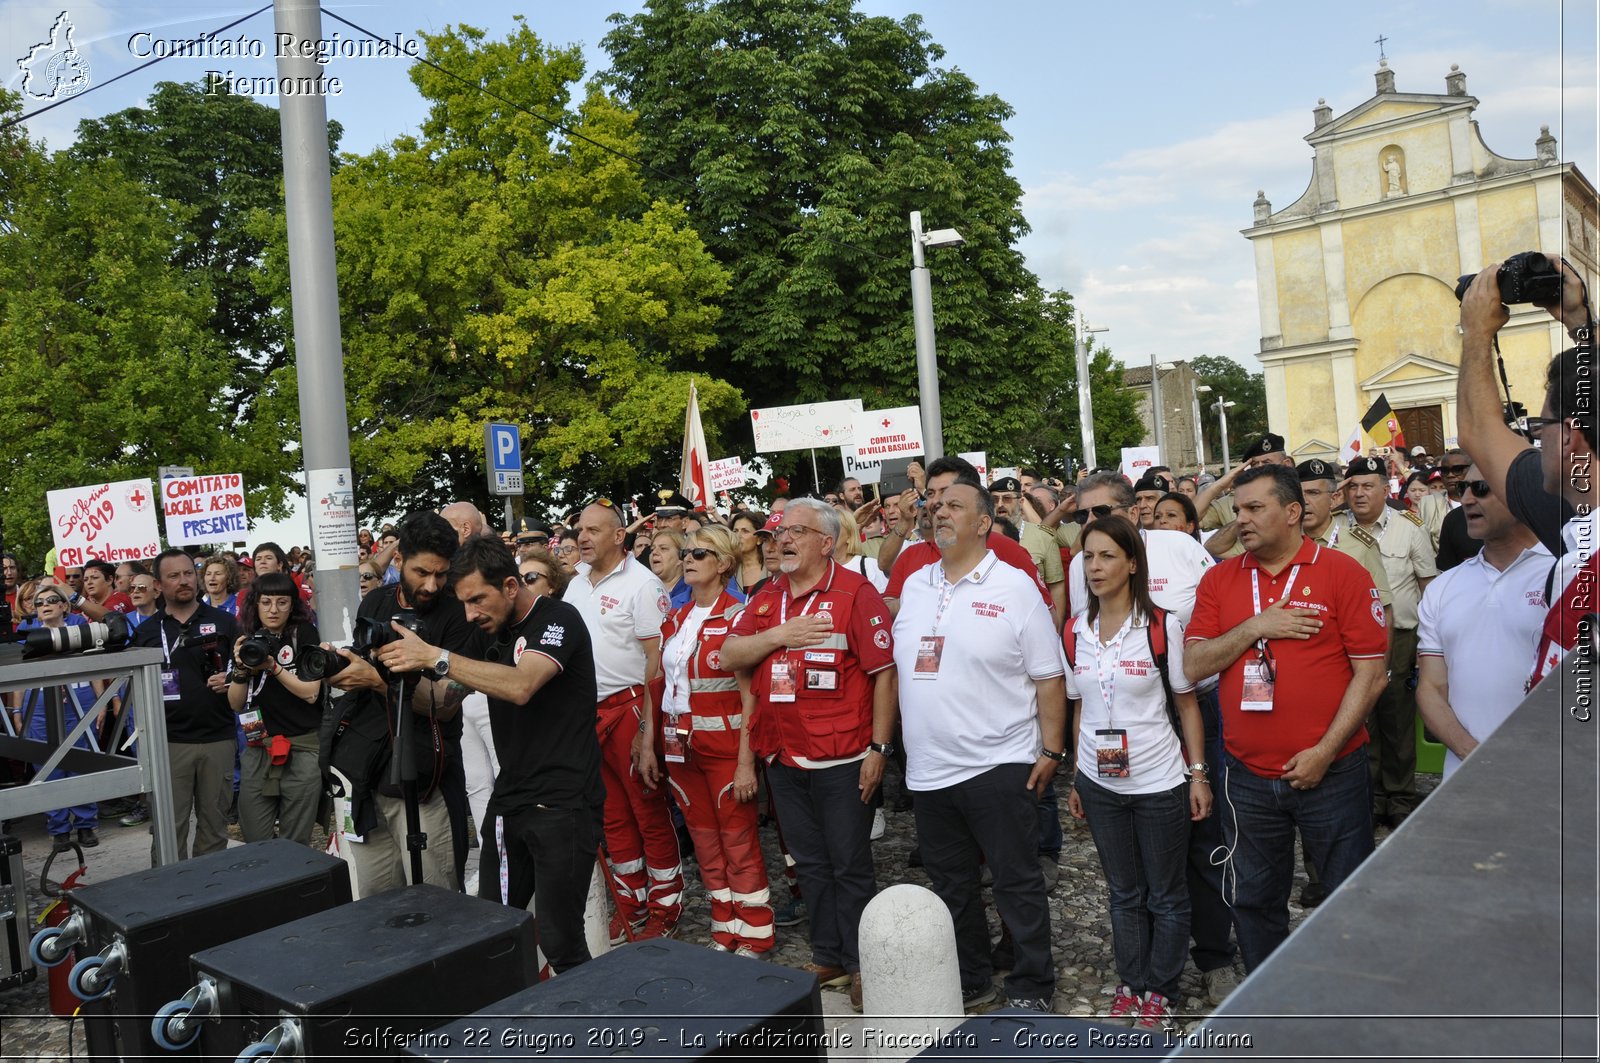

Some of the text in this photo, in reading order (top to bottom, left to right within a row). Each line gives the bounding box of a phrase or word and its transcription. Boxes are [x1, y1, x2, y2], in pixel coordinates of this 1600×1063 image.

[808, 404, 816, 416] 6
[870, 434, 906, 445] COMITATO
[497, 431, 514, 465] P
[867, 446, 887, 455] VILLA
[888, 442, 921, 453] BASILICA
[846, 456, 883, 472] PALIA
[166, 474, 240, 498] COMITATO
[723, 477, 742, 486] CASSA
[58, 484, 110, 538] Solferino
[164, 493, 243, 516] LOCALE AGRO
[80, 500, 114, 542] 2019
[183, 512, 245, 537] PRESENTE
[59, 548, 82, 567] CRI
[86, 542, 141, 564] Salerno
[976, 609, 998, 617] ITALIANA
[989, 604, 1005, 613] ROSSA
[1309, 603, 1328, 612] ROSSA
[1125, 668, 1147, 676] ITALIANA
